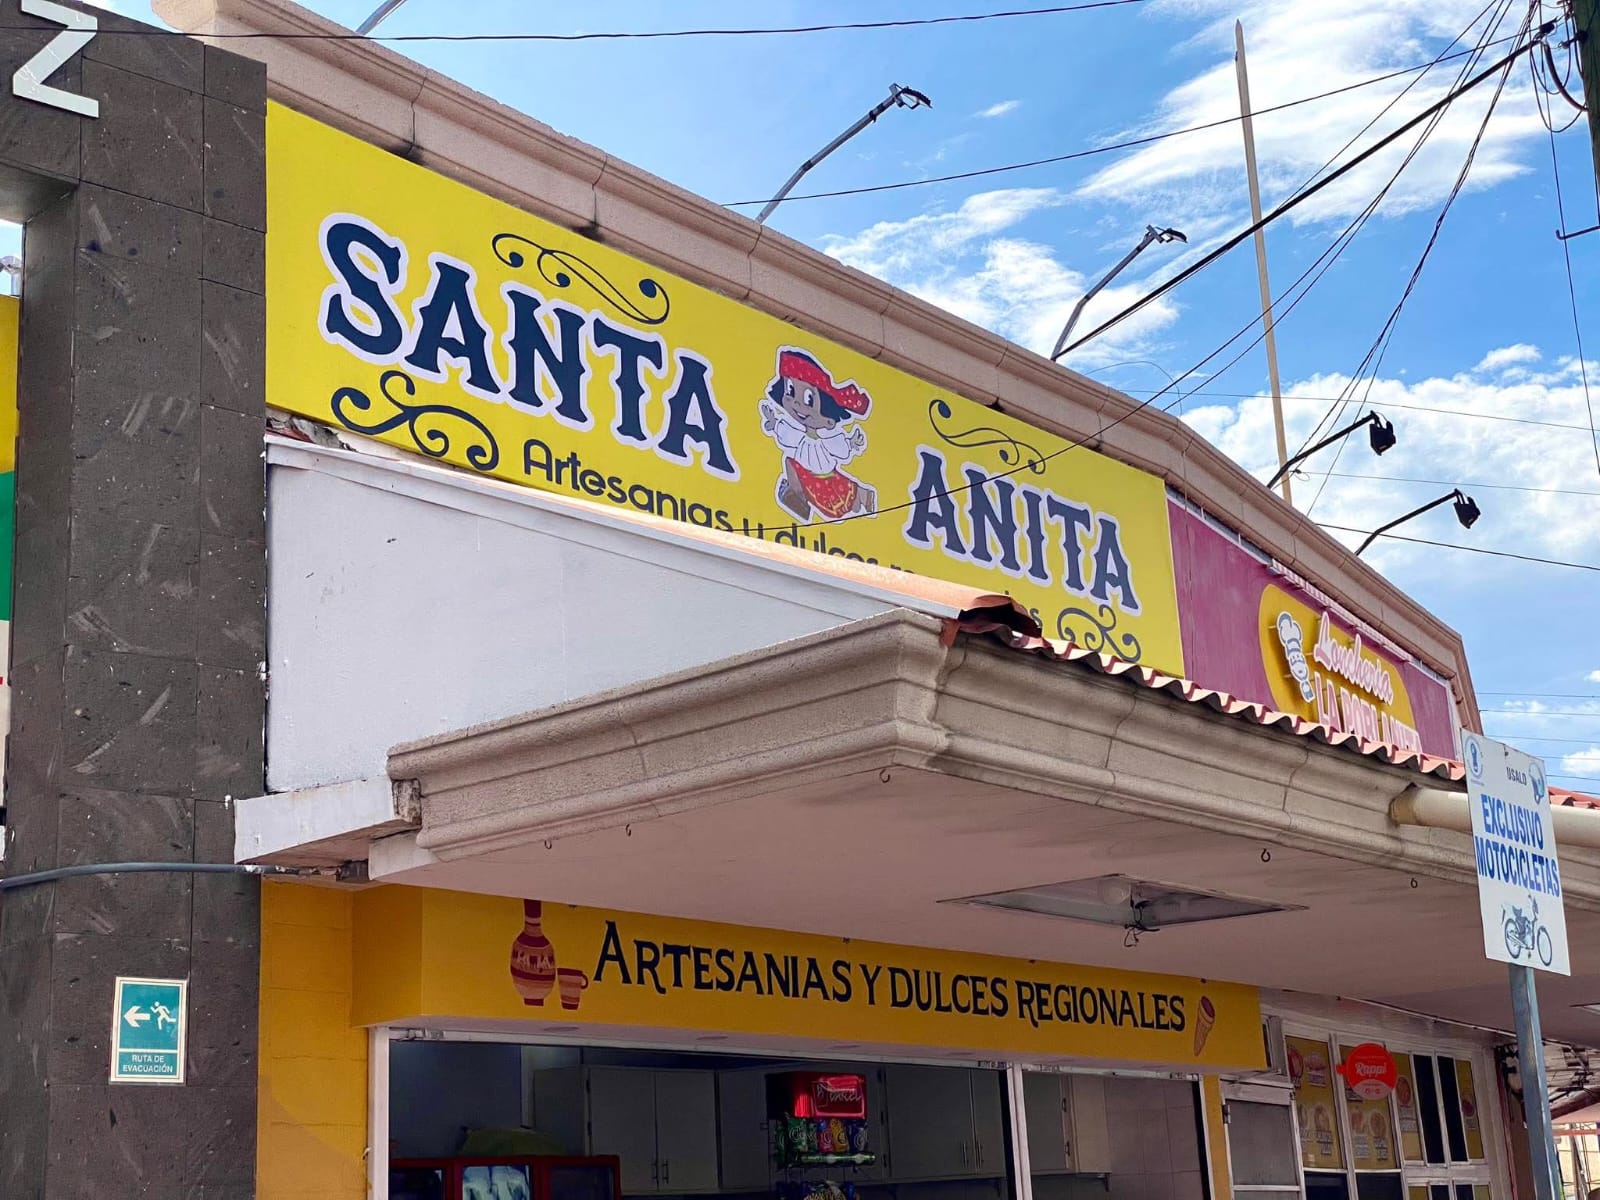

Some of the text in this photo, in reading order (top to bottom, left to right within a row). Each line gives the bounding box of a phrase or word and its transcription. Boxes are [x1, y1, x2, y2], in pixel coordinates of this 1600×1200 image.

[321, 214, 1141, 615] SANTA ANITA
[1481, 794, 1544, 850] EXCLUSIVO
[1475, 836, 1560, 898] MOTOCICLETAS
[593, 920, 1186, 1032] ARTESANIAS Y DULCES REGIONALES
[122, 1063, 173, 1073] EVACUACIÓN
[132, 1054, 165, 1063] RUTA DE
[1355, 1062, 1387, 1078] Rappi
